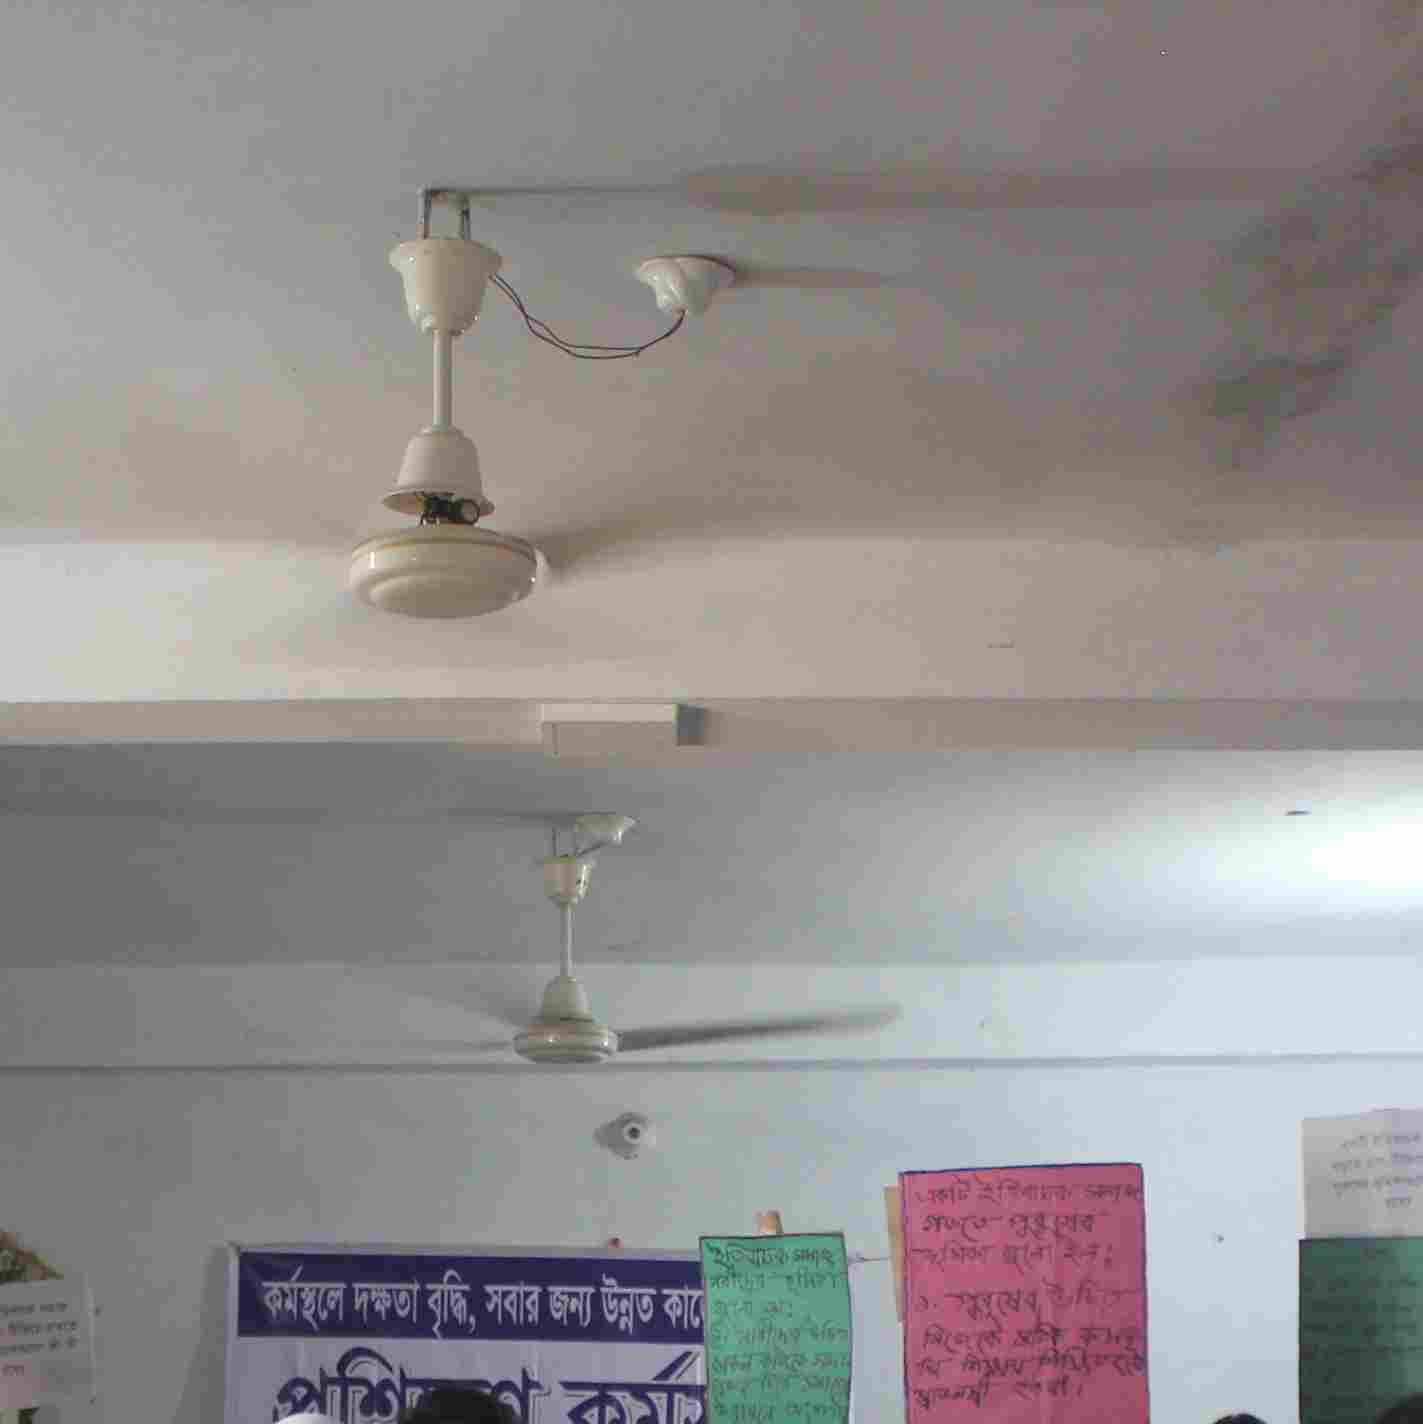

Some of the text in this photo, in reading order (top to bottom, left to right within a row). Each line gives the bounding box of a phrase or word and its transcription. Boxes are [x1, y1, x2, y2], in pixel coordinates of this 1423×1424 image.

[261, 1265, 348, 1332] কর্মস্থলে
[352, 1278, 422, 1326] দক্ষতা
[426, 1269, 476, 1339] বৃদ্ধি,
[484, 1281, 542, 1326] সবার
[547, 1285, 595, 1328] জন্য
[600, 1272, 658, 1336] উন্নত
